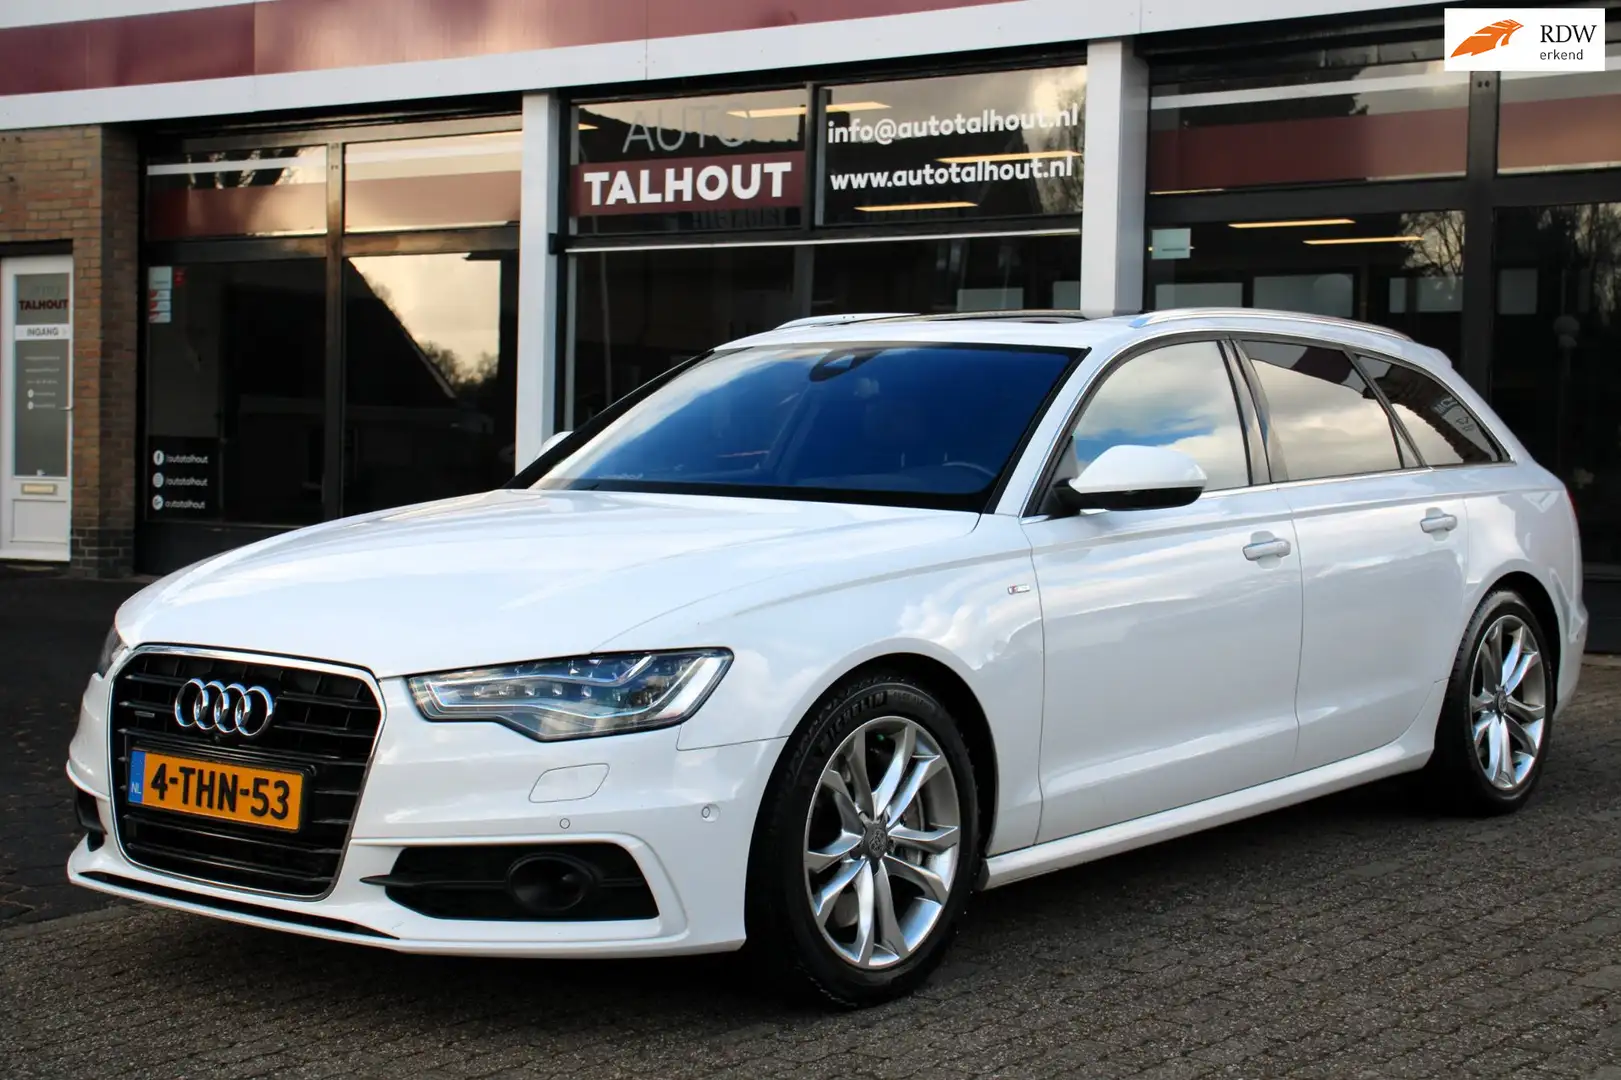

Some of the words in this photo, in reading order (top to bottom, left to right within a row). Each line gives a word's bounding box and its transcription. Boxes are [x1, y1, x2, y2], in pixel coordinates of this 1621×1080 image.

[621, 101, 750, 154] AUTO
[827, 103, 1078, 145] info@autotalhout.nl
[583, 161, 792, 206] TALHOUT
[830, 156, 1073, 191] www.autotalhout.nl
[18, 298, 69, 311] TALHOUT
[26, 326, 59, 337] INGANG
[130, 782, 142, 795] NL
[151, 762, 290, 821] 4-THN-53
